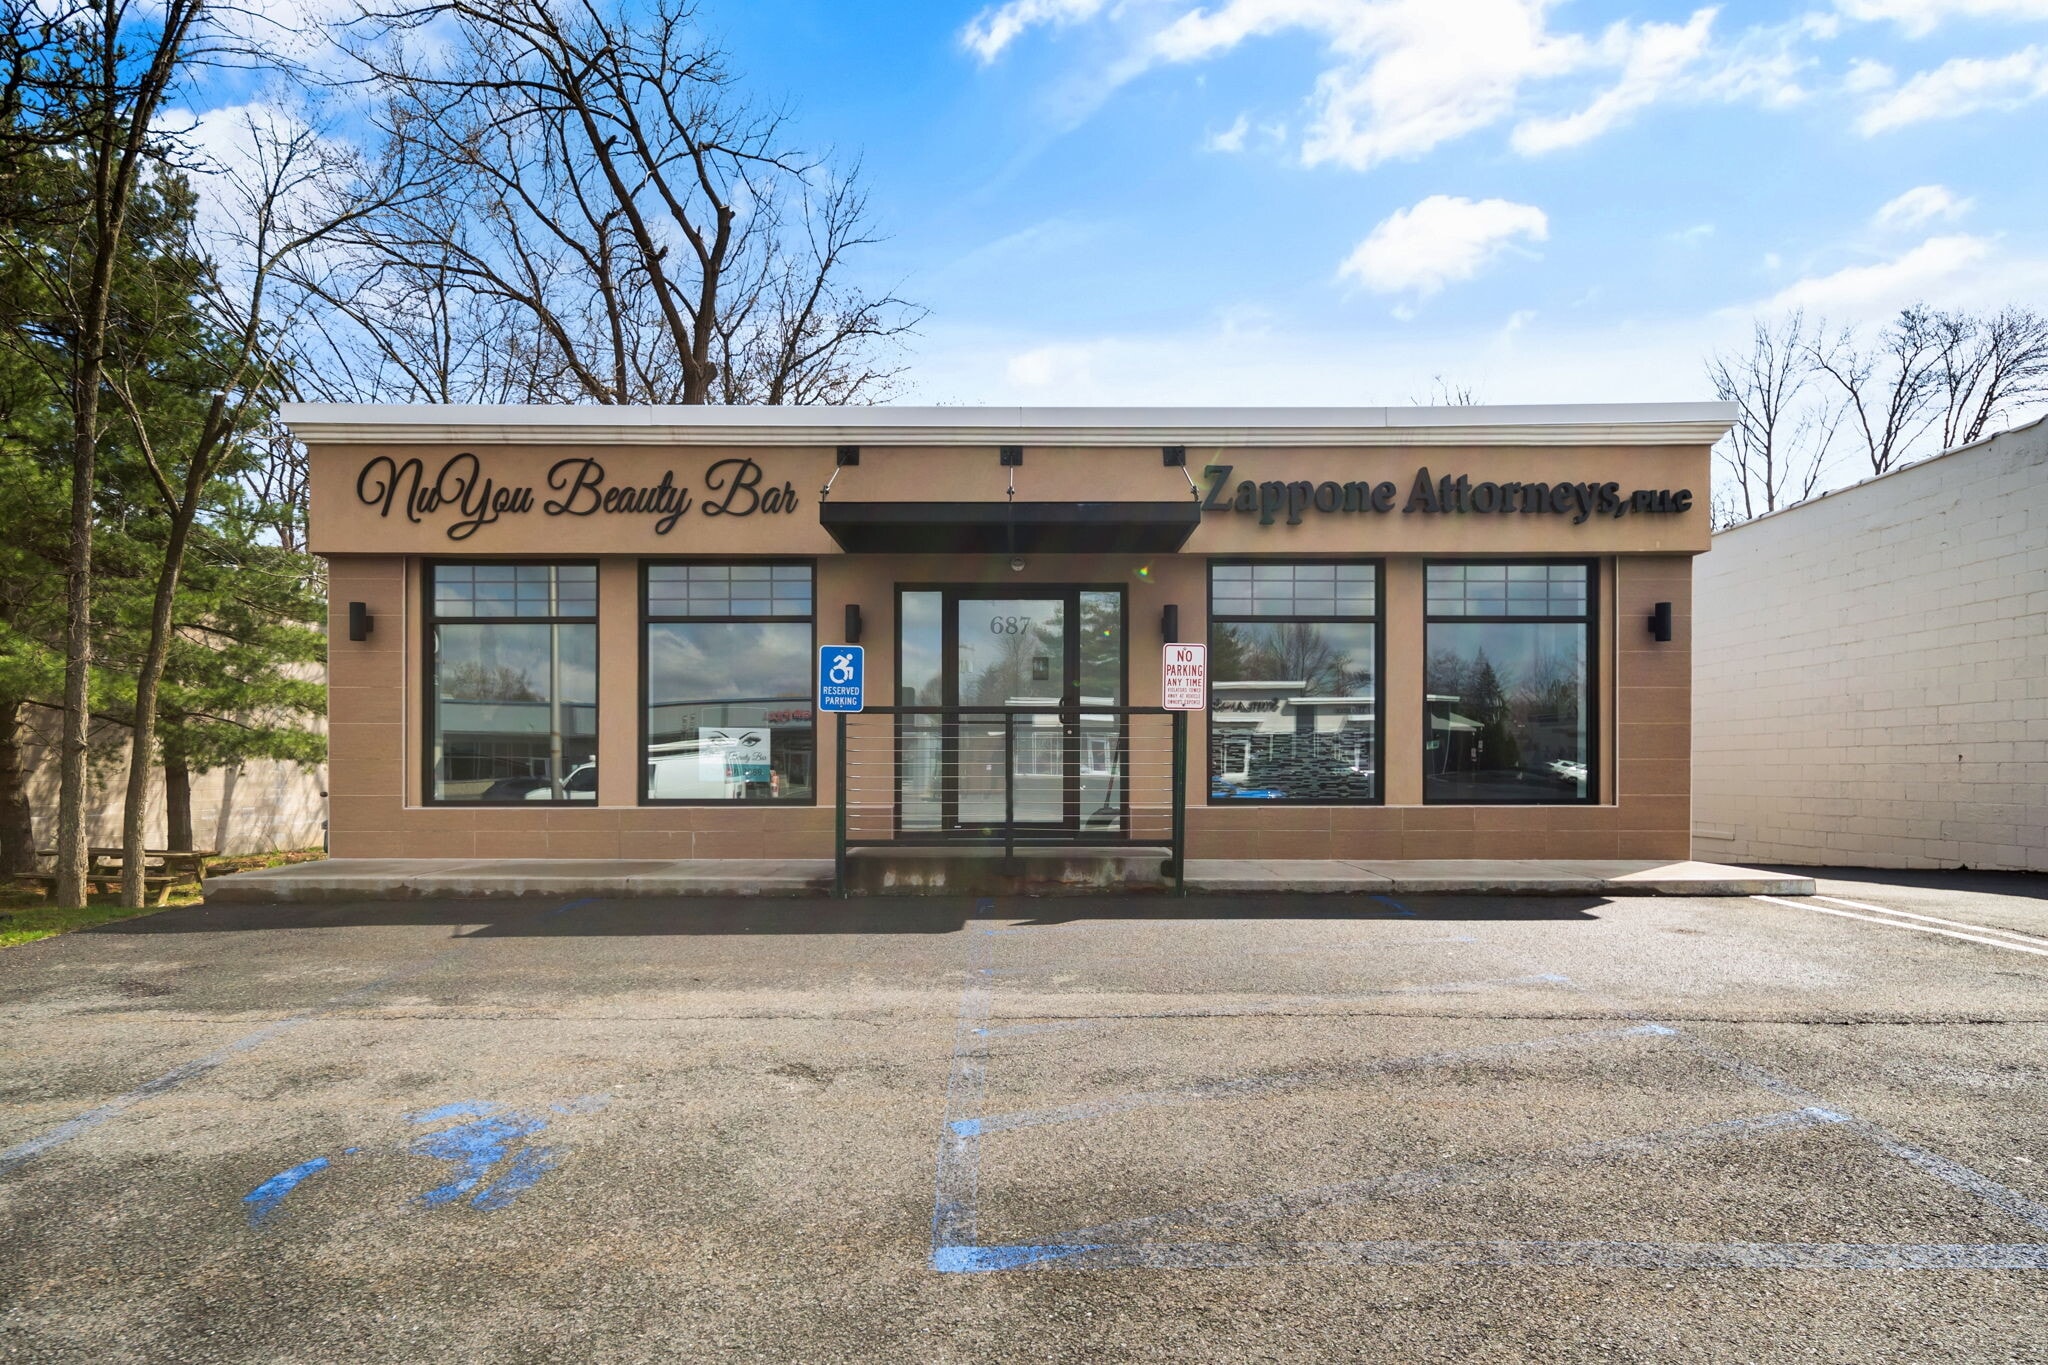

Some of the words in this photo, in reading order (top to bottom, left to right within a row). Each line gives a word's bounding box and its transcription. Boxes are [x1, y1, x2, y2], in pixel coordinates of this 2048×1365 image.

[357, 453, 534, 541] NuYou
[544, 457, 692, 535] Beauty
[701, 457, 798, 517] Bar
[1202, 465, 1397, 525] Zappone
[1402, 467, 1631, 525] Attorneys,
[1631, 489, 1692, 513] PLLC
[990, 616, 1031, 635] 687
[1177, 650, 1193, 662] NO
[1166, 664, 1203, 677] PARKING
[1167, 678, 1182, 687] ANY
[1185, 679, 1202, 687] TIME
[823, 686, 860, 696] RESERVED
[825, 696, 857, 706] PARKING
